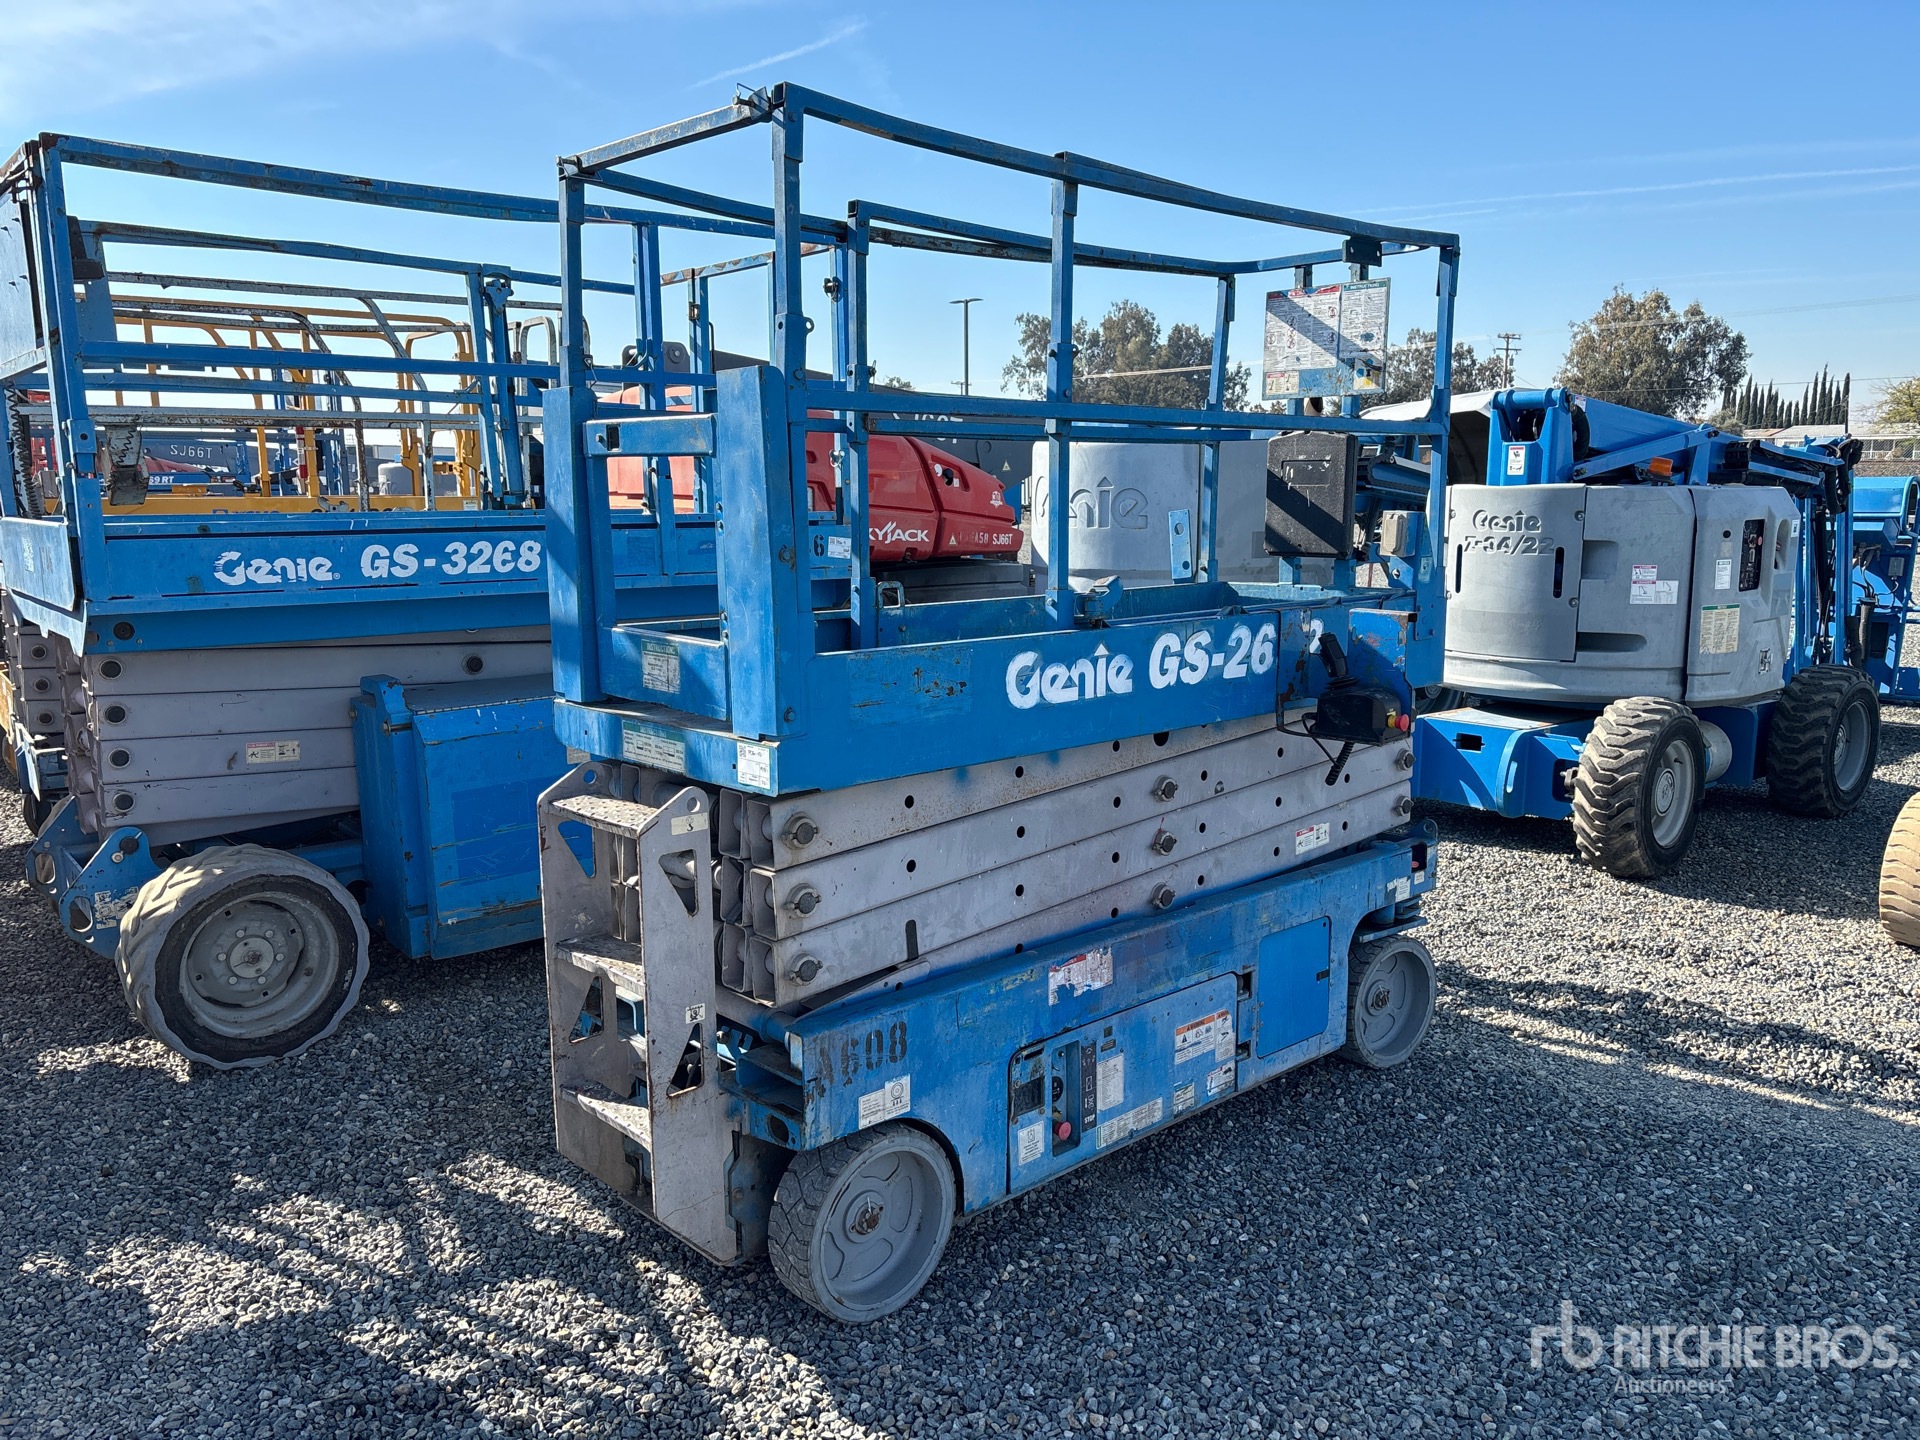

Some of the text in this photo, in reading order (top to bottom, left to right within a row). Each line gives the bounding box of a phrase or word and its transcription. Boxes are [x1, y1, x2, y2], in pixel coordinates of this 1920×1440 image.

[170, 444, 213, 459] SJ66T
[1473, 508, 1542, 533] Genie
[992, 533, 1013, 545] SJ66T
[1464, 534, 1555, 555] Z-34/22
[213, 540, 541, 586] Genie GS-3268
[1005, 643, 1134, 709] Genie
[1084, 1113, 1096, 1124] STOP
